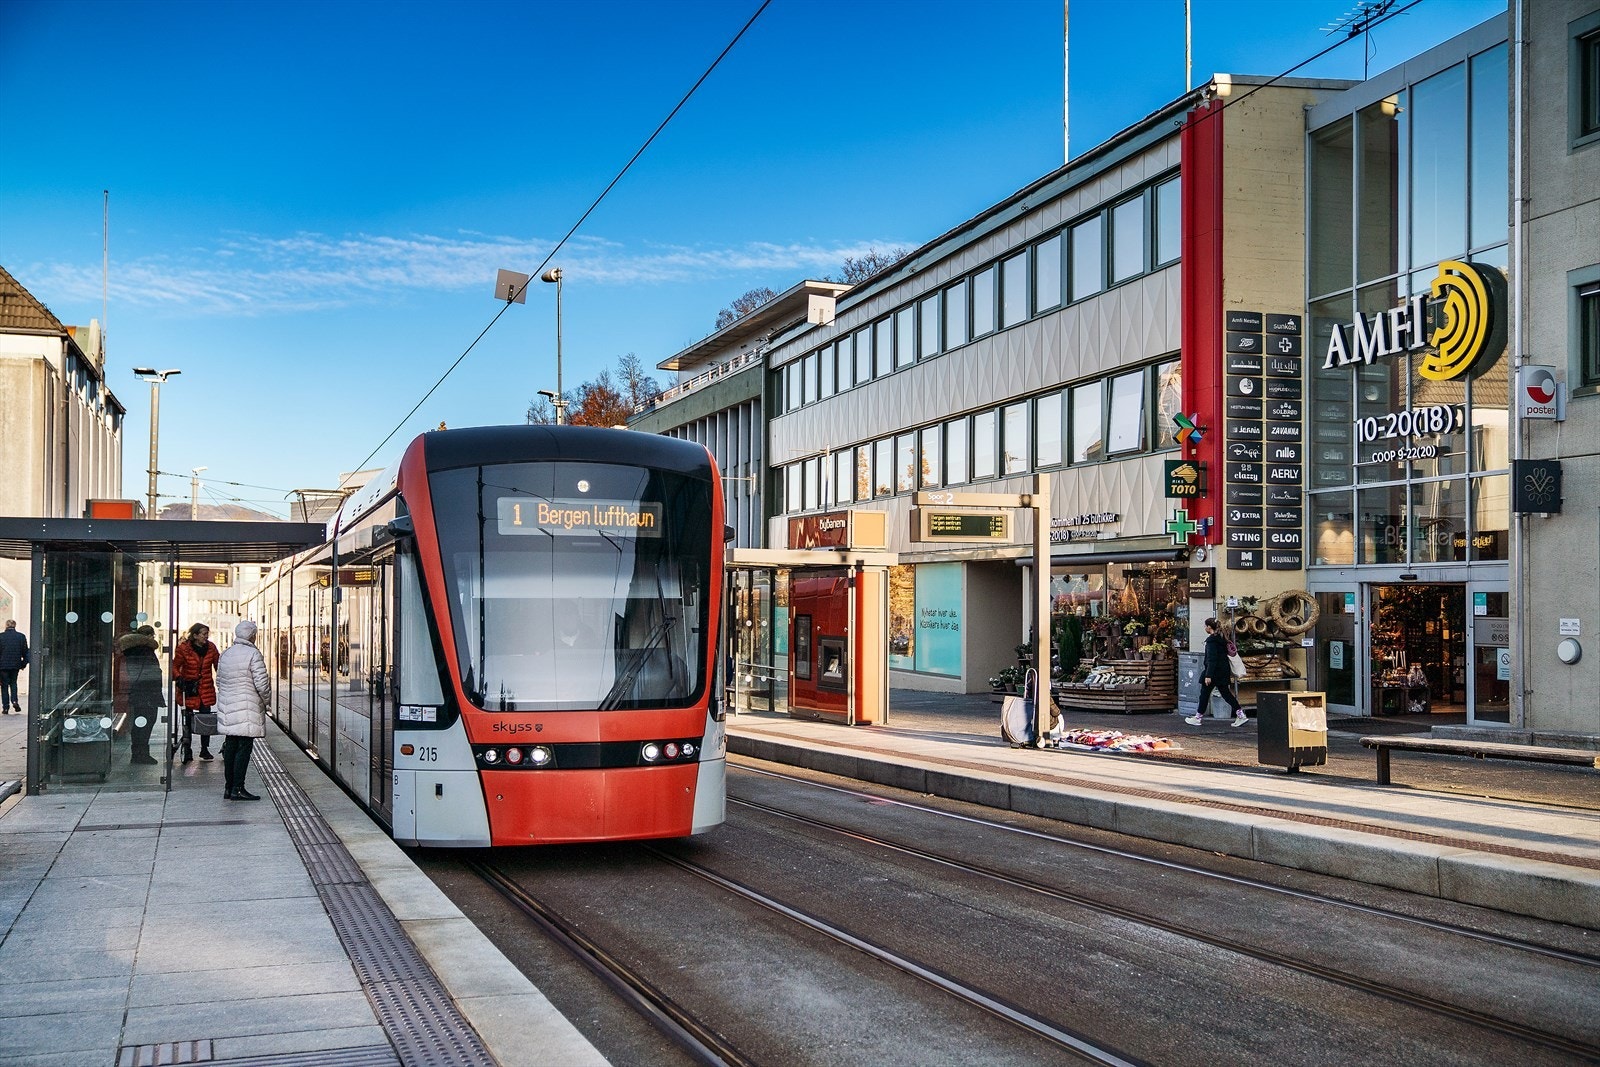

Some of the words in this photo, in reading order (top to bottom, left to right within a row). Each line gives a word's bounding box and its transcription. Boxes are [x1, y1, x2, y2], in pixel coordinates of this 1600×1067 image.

[1273, 322, 1297, 330] sunkost
[1322, 295, 1426, 369] AMFI
[1526, 406, 1556, 416] posten
[1357, 404, 1453, 442] 10-20(18)
[1271, 427, 1298, 436] ZAVANNA
[1276, 447, 1295, 458] nille
[1372, 450, 1396, 462] COOP
[1397, 445, 1436, 460] 9-22(20)
[1234, 471, 1258, 482] clazzy
[1271, 469, 1299, 478] AERLY
[1171, 484, 1196, 494] TOTO
[928, 492, 944, 501] Spor
[946, 493, 954, 504] 2
[513, 504, 522, 526] 1
[538, 504, 590, 530] Bergen
[594, 504, 654, 528] lufthavn
[1082, 514, 1090, 524] 25
[1090, 513, 1115, 524] butikker
[1232, 533, 1260, 542] STING
[493, 721, 532, 734] skyss
[419, 746, 438, 762] 215
[394, 775, 399, 786] B
